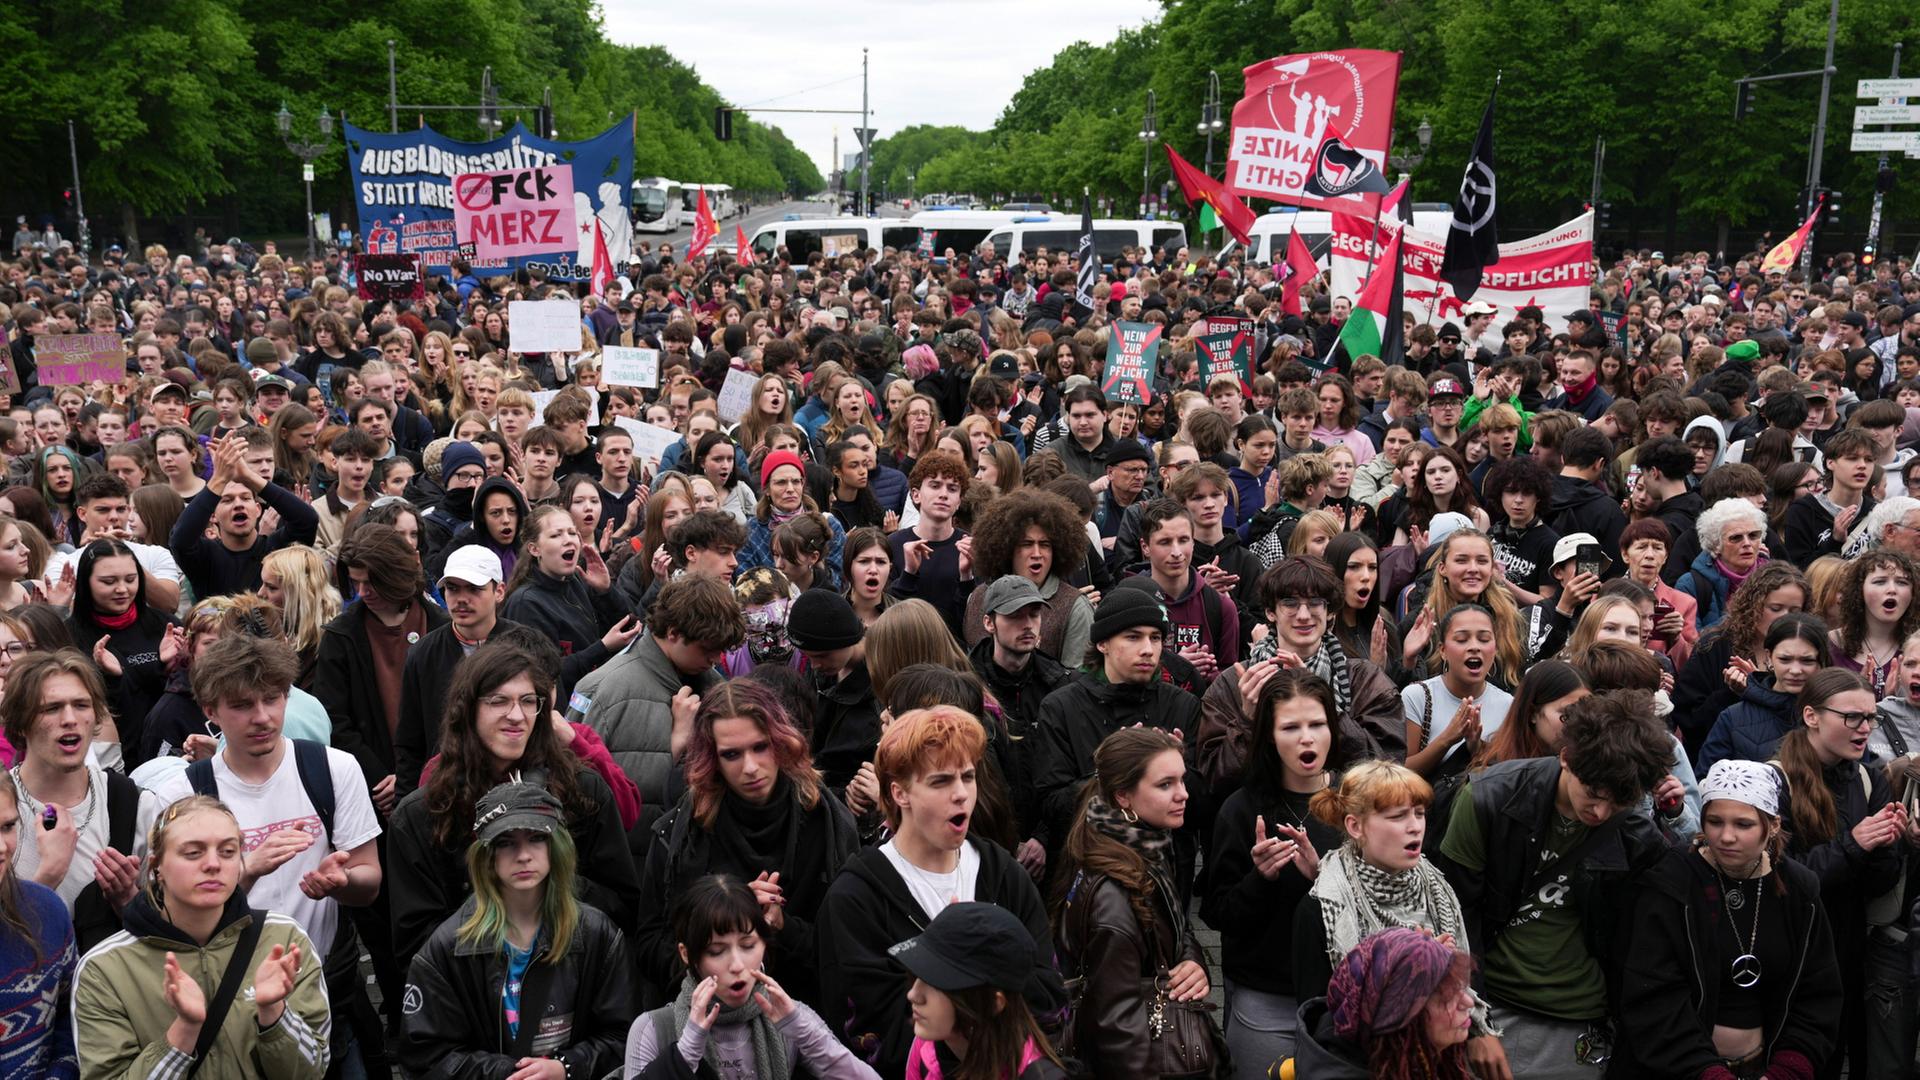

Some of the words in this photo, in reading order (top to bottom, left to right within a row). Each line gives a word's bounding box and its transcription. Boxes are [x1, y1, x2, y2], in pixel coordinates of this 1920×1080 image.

[362, 181, 415, 206] STATT
[494, 169, 557, 205] FCK
[471, 209, 563, 245] MERZ
[363, 270, 384, 282] No
[384, 260, 420, 283] War!
[1481, 261, 1590, 288] RPFLICHT!
[1124, 330, 1146, 342] NEIN
[1123, 342, 1142, 354] ZUR
[1209, 339, 1232, 352] NEIN
[1116, 354, 1147, 366] WEHR-
[1212, 351, 1231, 362] ZUR
[1109, 365, 1149, 379] PFLICHT
[1207, 362, 1239, 373] WEHR-
